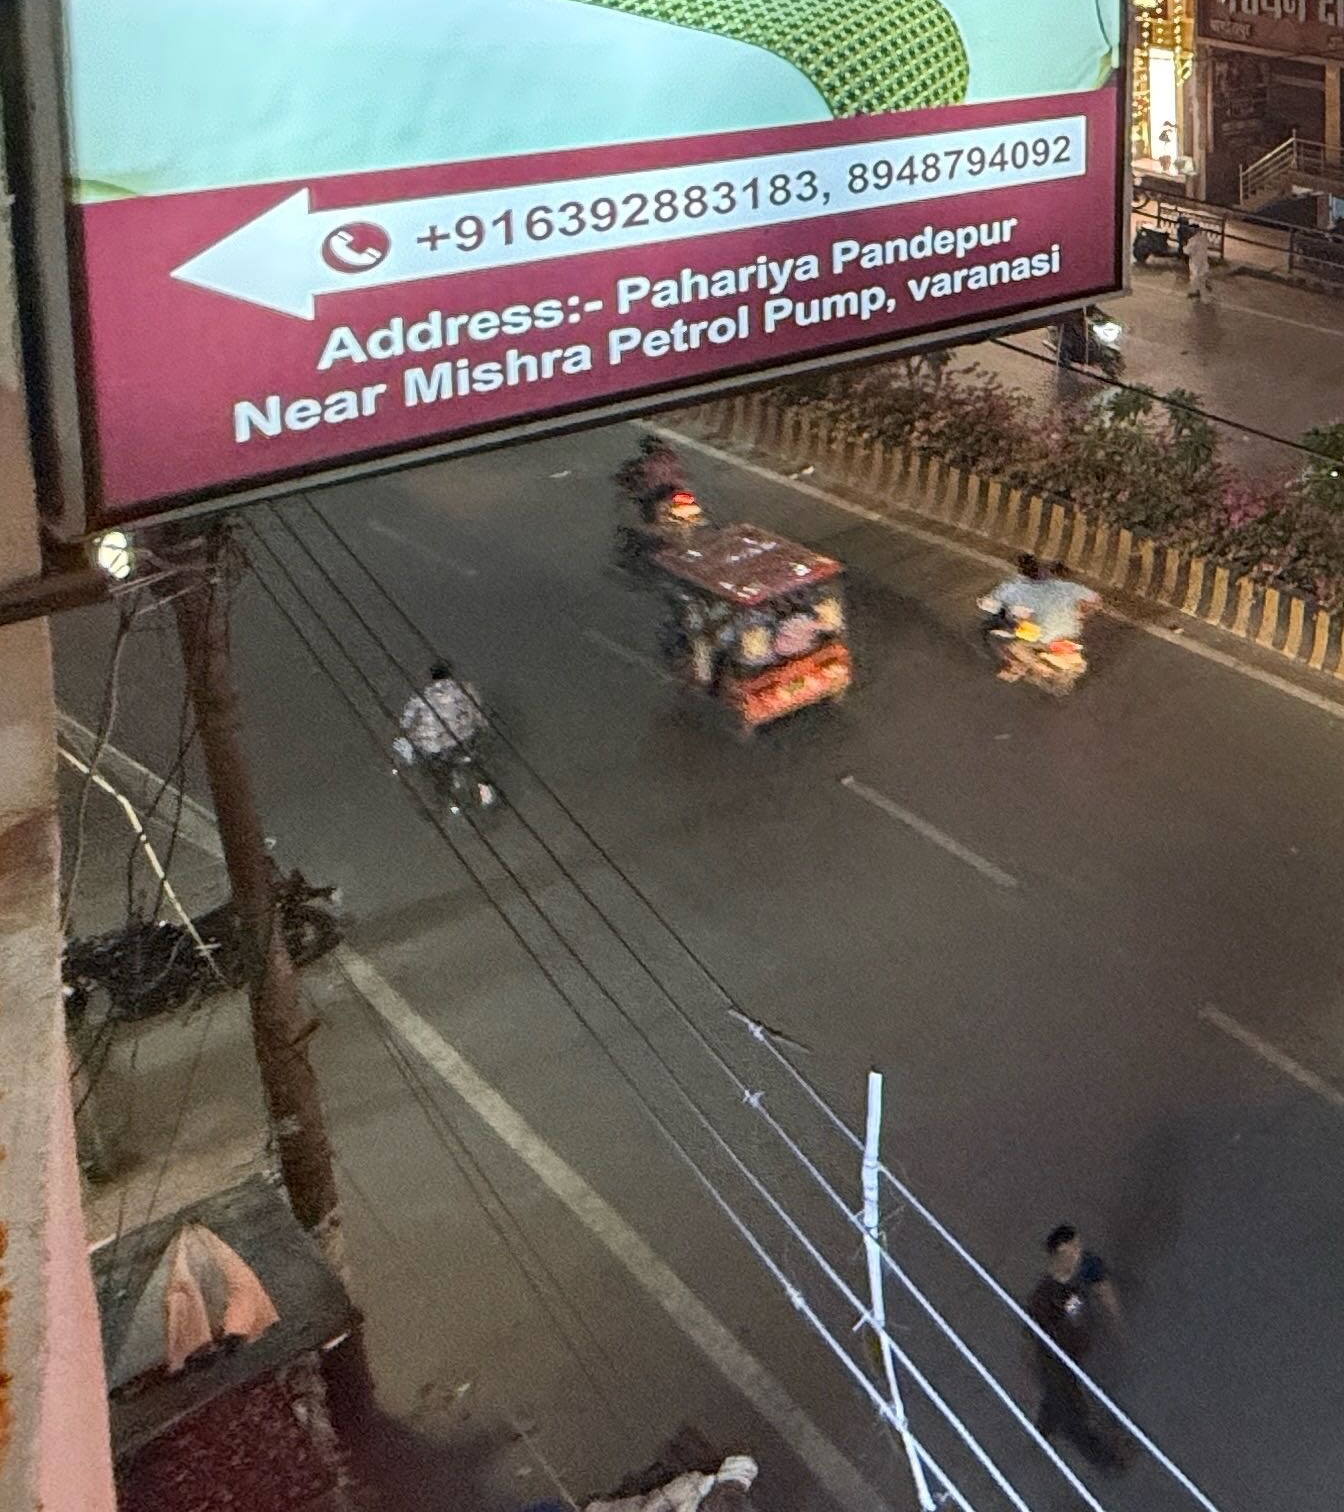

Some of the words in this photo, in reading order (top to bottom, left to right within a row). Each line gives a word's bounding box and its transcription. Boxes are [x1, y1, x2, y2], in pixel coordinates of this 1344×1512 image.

[416, 168, 833, 253] +916392883183,
[846, 134, 1073, 195] 8948794092
[233, 382, 389, 444] Near
[403, 344, 594, 408] Mishra
[608, 305, 750, 366] Petrol
[764, 285, 897, 334] Pump,
[907, 243, 1061, 303] varanasi
[316, 294, 605, 371] Address:-
[616, 253, 821, 316] Pahariya
[832, 215, 1020, 276] Pandepur
